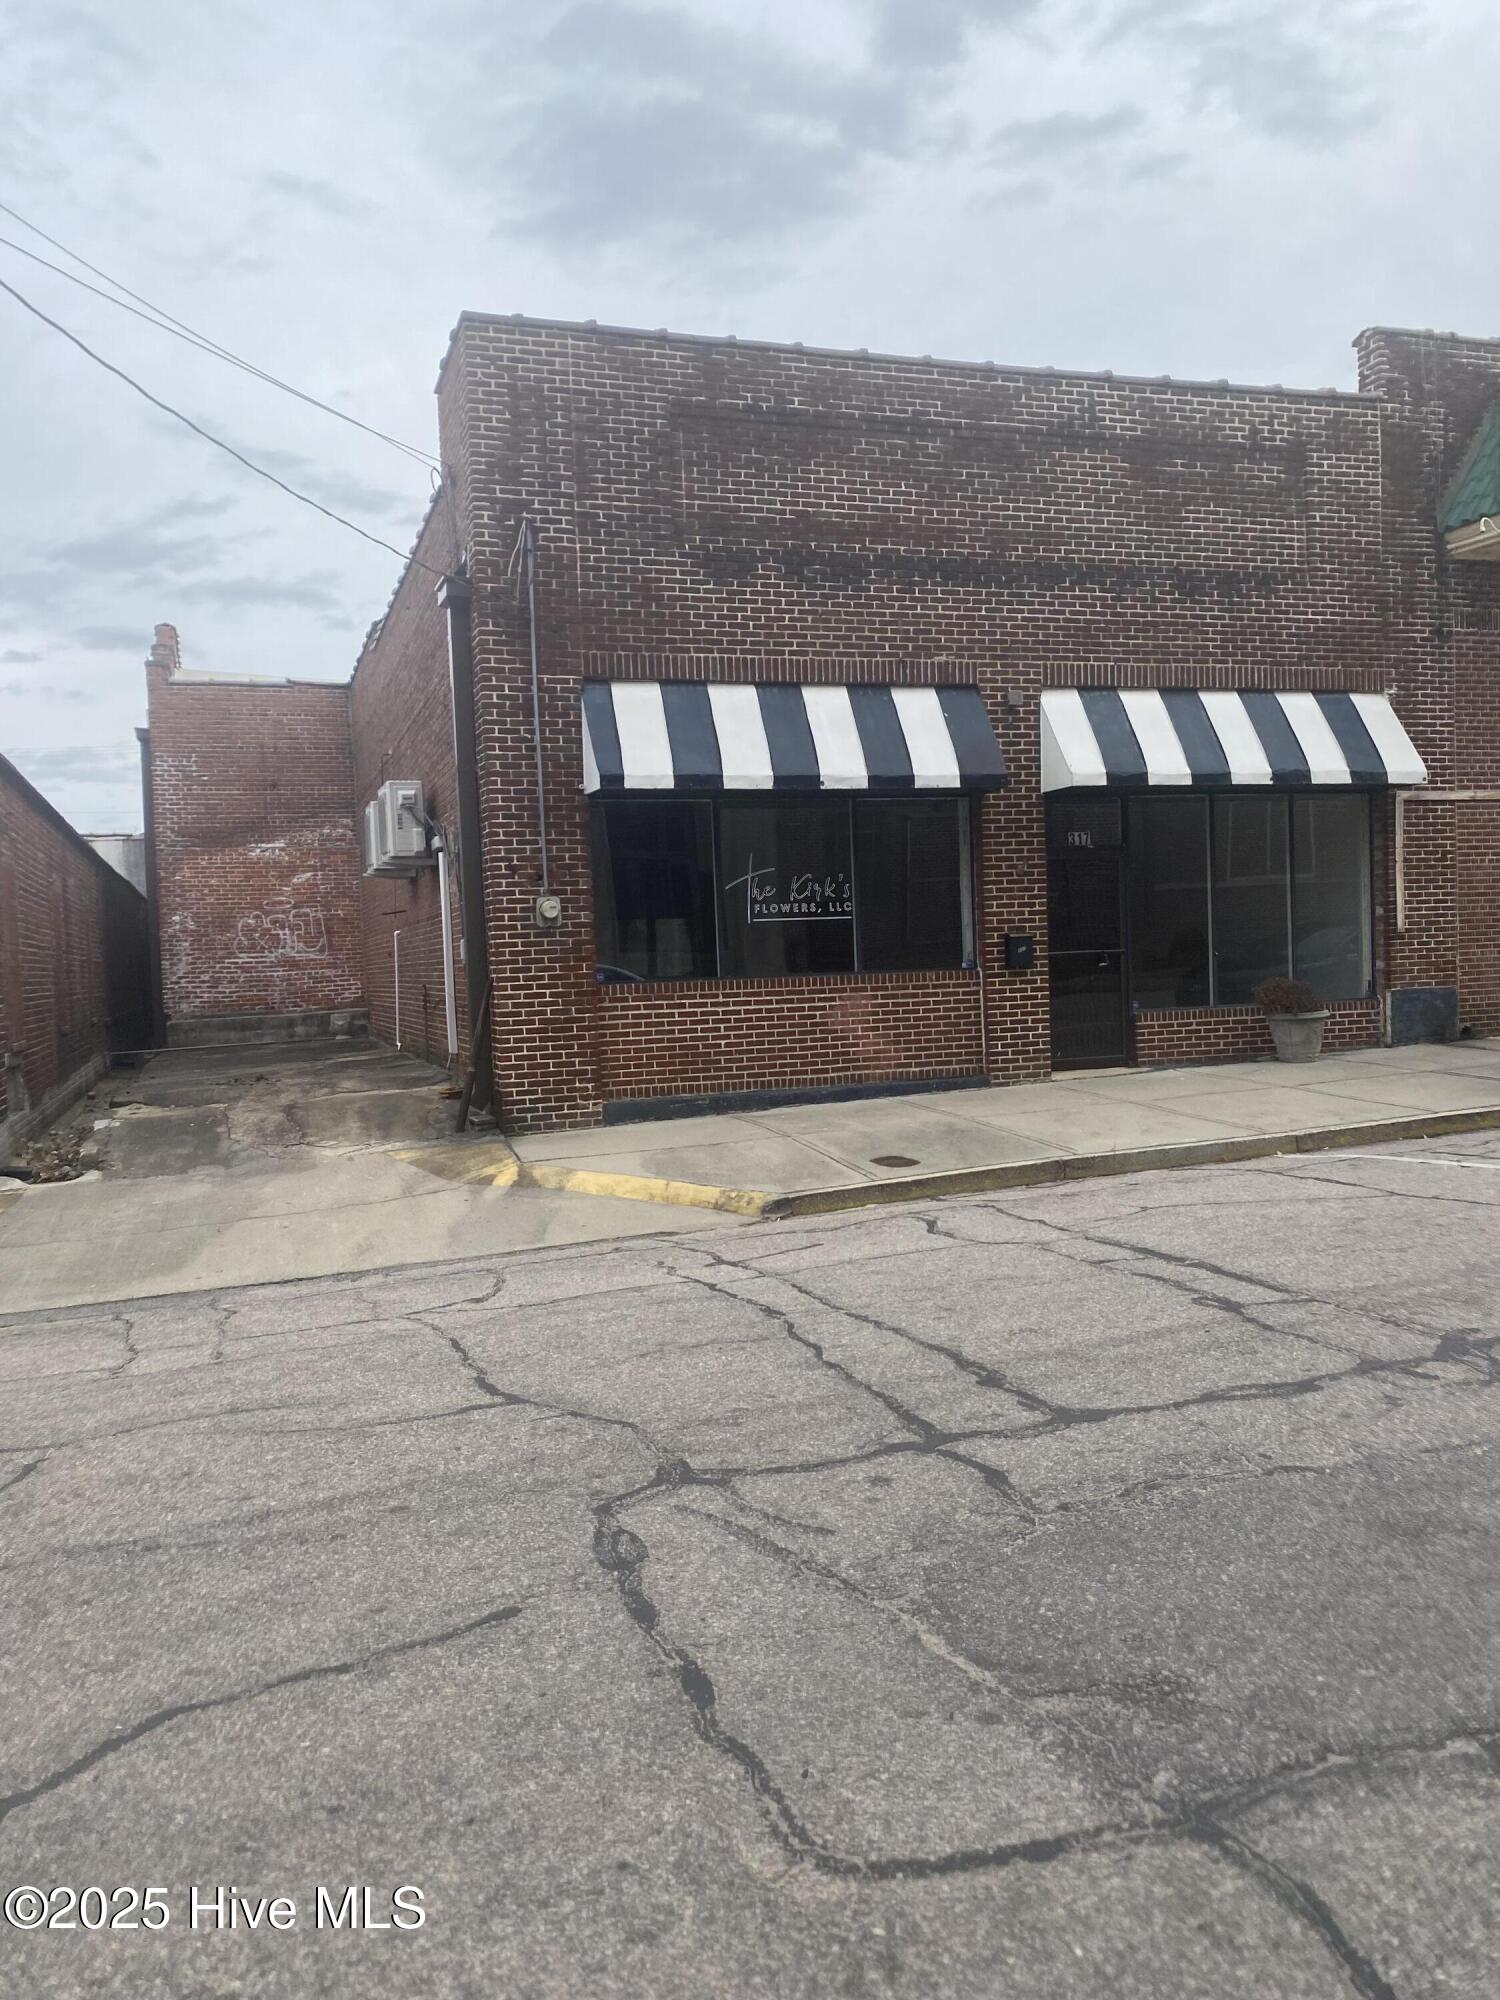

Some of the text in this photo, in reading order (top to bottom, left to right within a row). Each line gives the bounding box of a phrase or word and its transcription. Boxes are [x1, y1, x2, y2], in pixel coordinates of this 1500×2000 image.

[1068, 832, 1090, 846] 317
[725, 853, 850, 923] The Kirk's
[754, 901, 853, 914] FLOWERS, LLC
